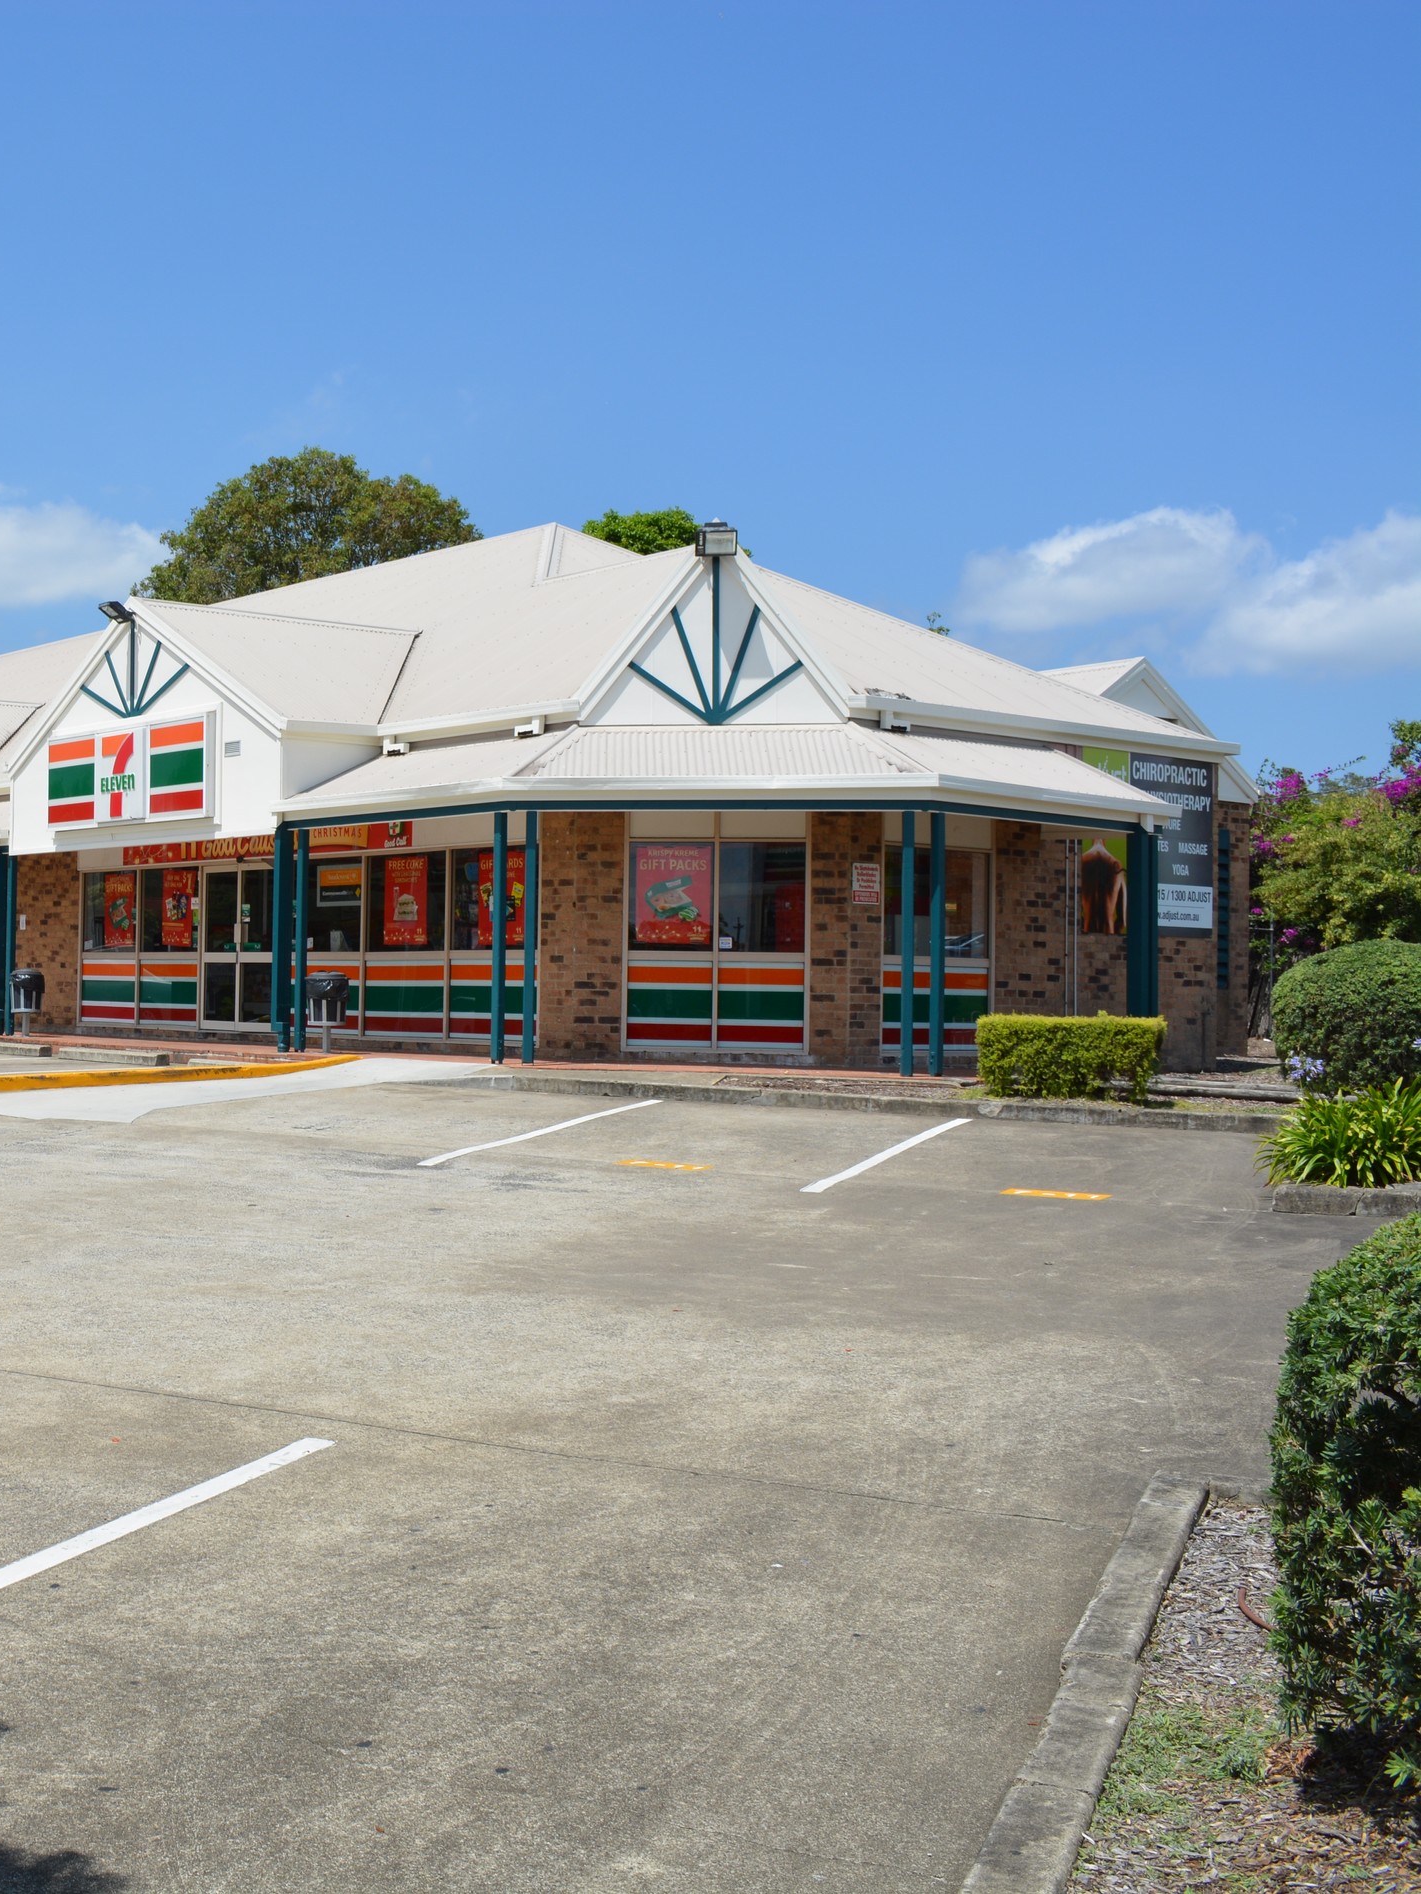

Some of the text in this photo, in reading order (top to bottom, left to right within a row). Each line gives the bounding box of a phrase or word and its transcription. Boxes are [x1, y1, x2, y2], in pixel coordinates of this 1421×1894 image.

[101, 732, 133, 818] 7
[1132, 760, 1207, 786] CHIROPRACTIC
[1145, 789, 1211, 812] YSIOTHERAPY
[313, 826, 362, 839] CHRISTMAS
[648, 848, 700, 857] KRISPY KREME
[1178, 842, 1209, 856] MASSAGE
[388, 859, 424, 870] FREE COKE
[506, 858, 524, 869] RDS
[640, 859, 708, 871] GIFT PACKS
[1172, 863, 1189, 876] YOGA
[1171, 889, 1187, 902] 1300
[1188, 891, 1211, 902] ADJUST
